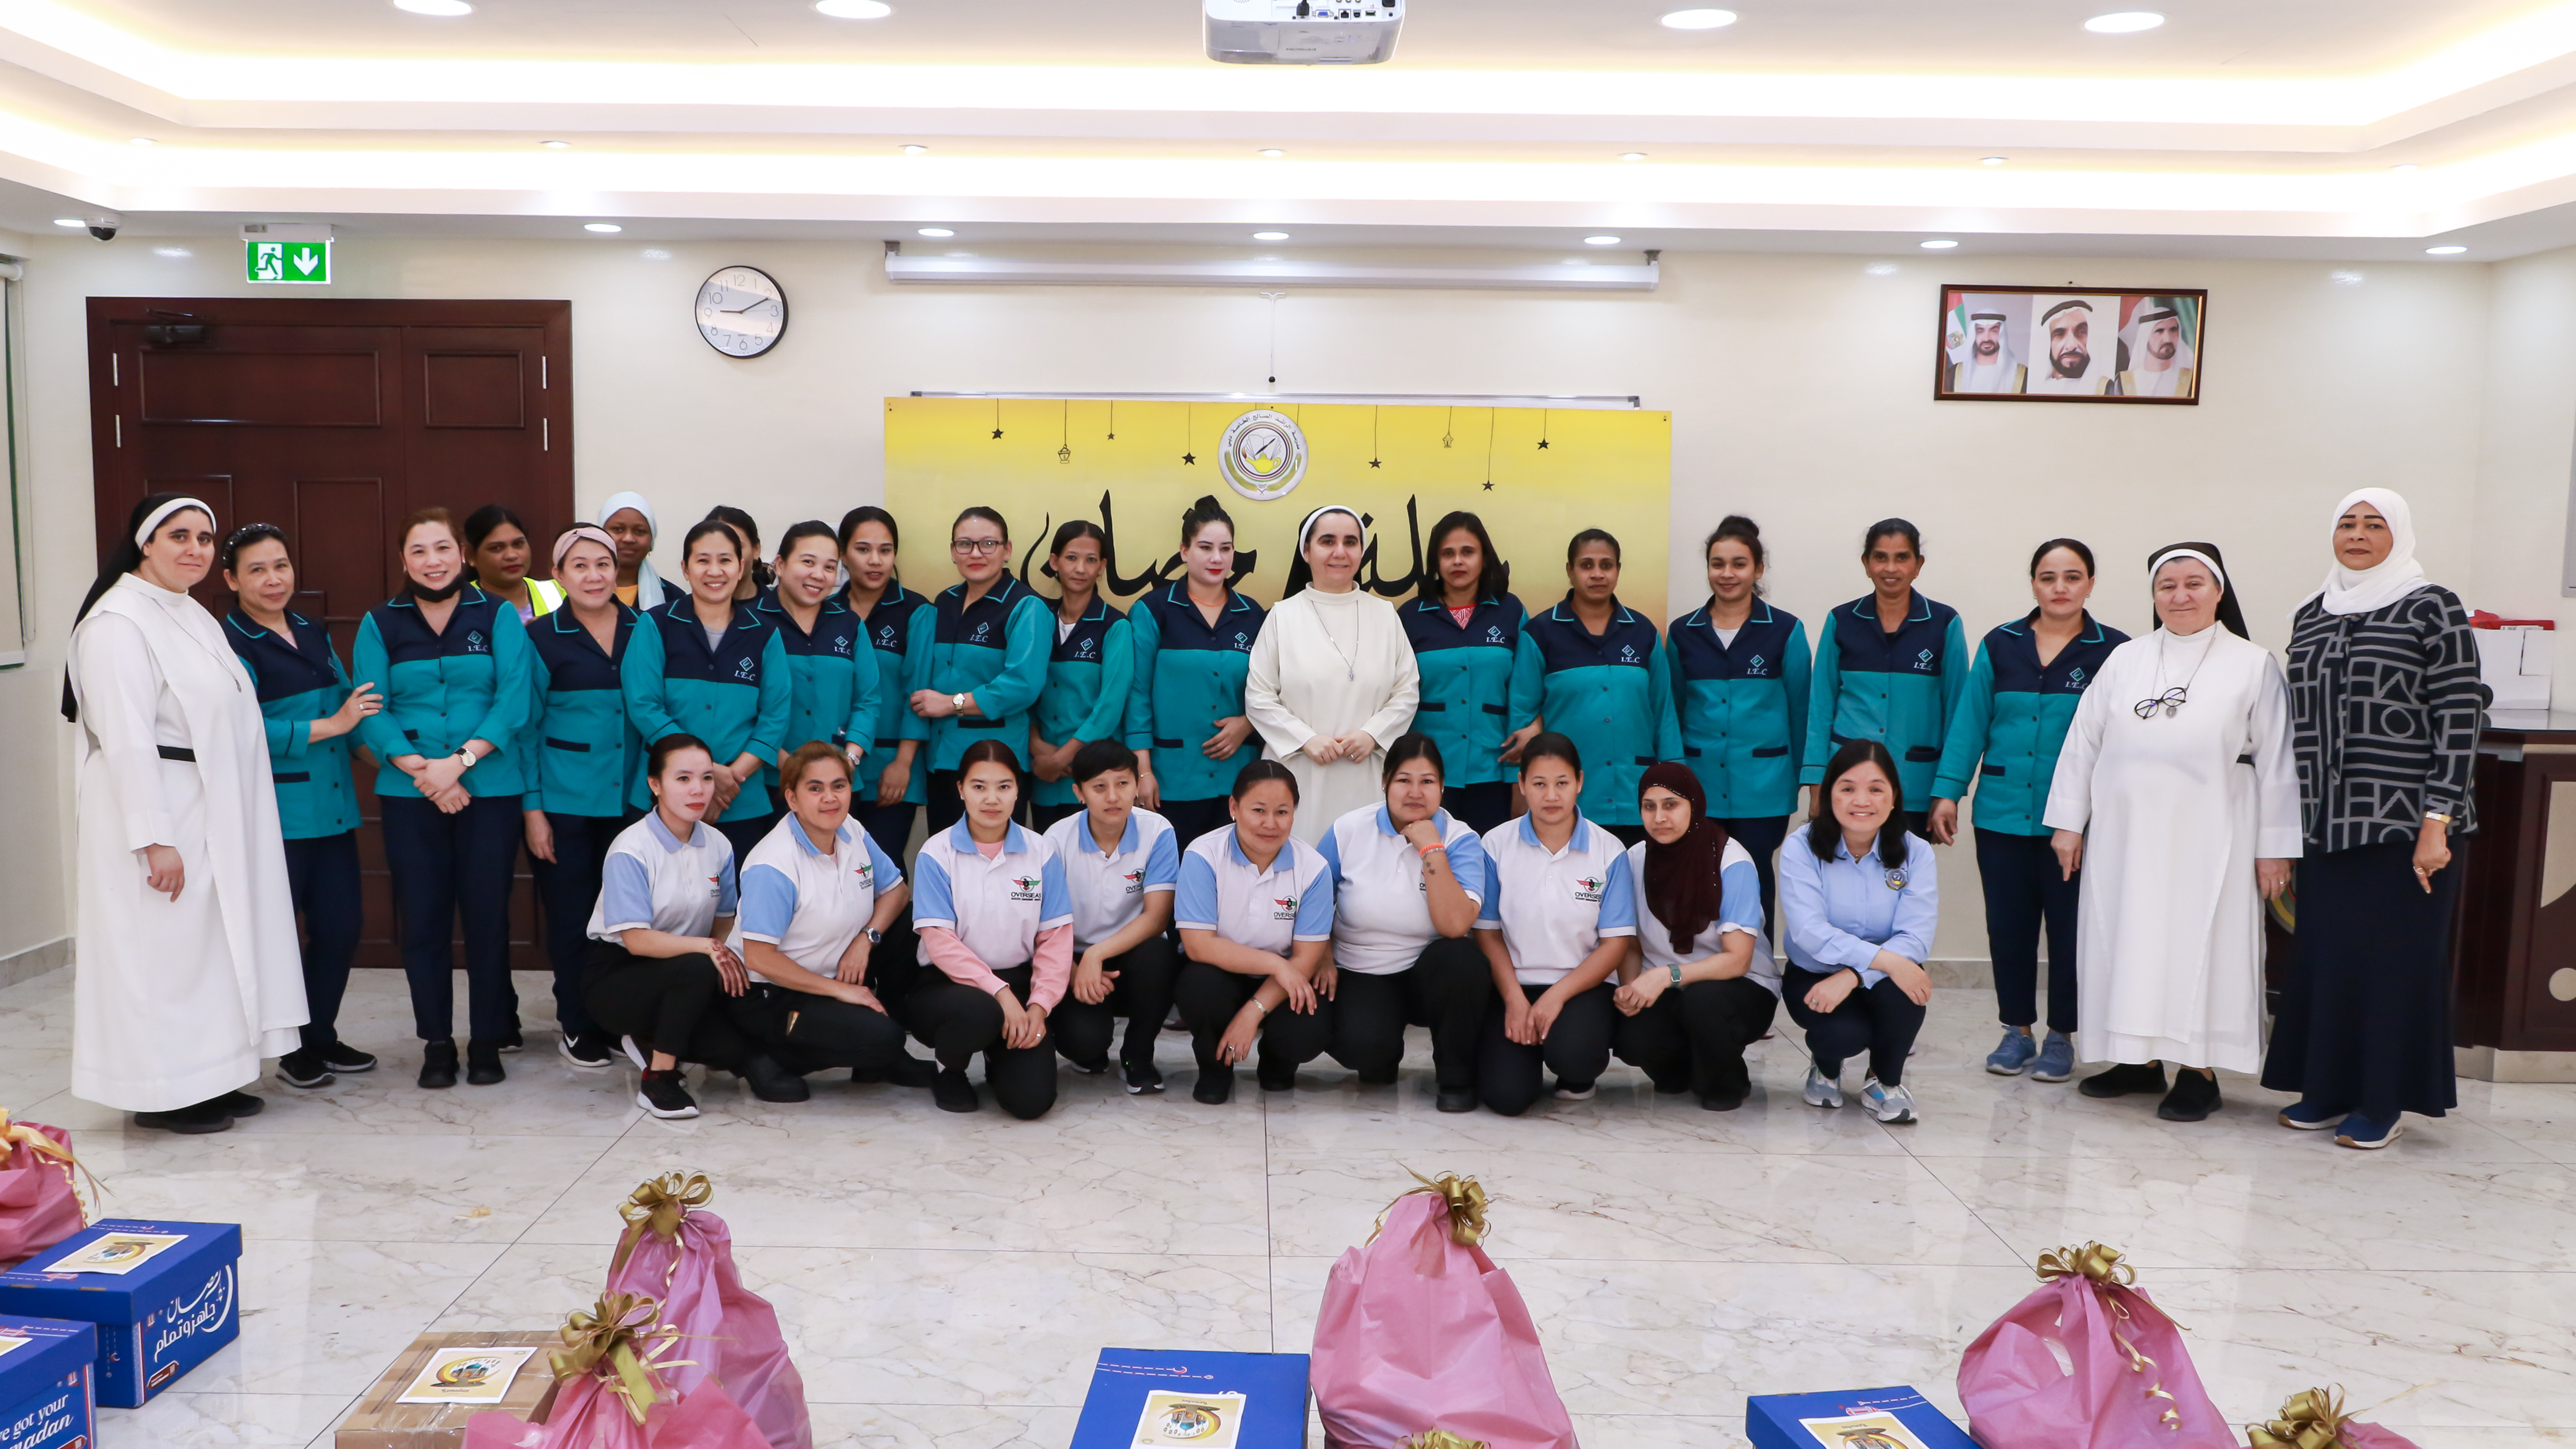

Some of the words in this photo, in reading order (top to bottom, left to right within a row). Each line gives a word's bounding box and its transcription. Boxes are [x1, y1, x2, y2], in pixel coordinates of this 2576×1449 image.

[720, 279, 728, 292] 11
[733, 274, 745, 286] 12
[754, 278, 757, 289] 1
[709, 292, 723, 304] 10
[704, 307, 712, 319] 9
[770, 305, 779, 317] 3
[711, 324, 718, 335] 8
[766, 322, 774, 334] 4
[723, 334, 731, 346] 7
[739, 338, 747, 350] 6
[755, 334, 763, 345] 5
[876, 638, 897, 647] I.E.C
[734, 670, 755, 680] I.E.C
[13, 1413, 35, 1440] got
[38, 1394, 69, 1425] your
